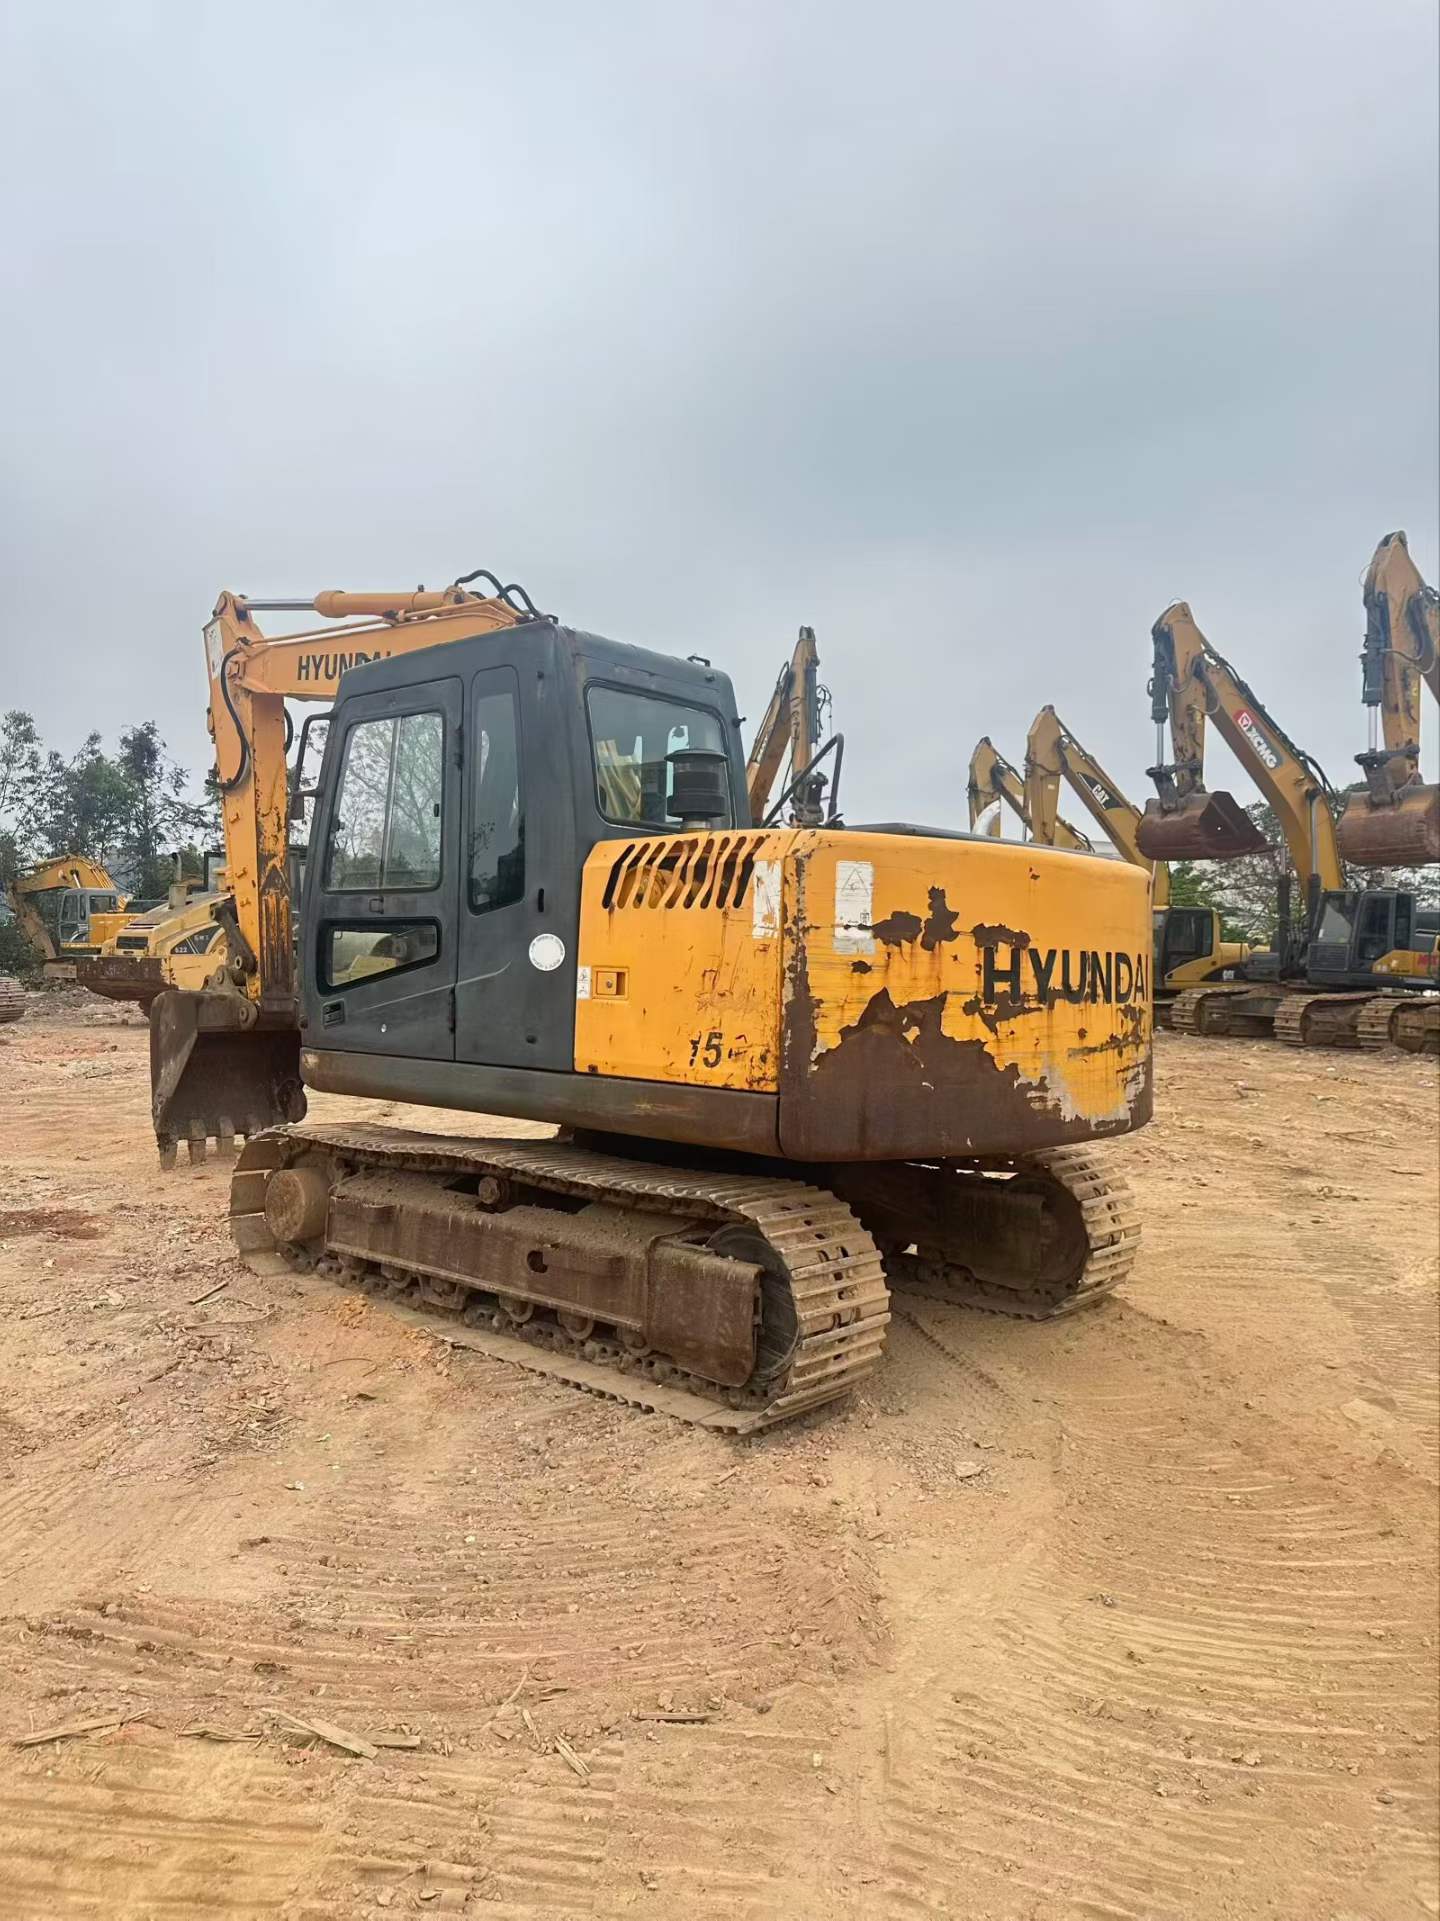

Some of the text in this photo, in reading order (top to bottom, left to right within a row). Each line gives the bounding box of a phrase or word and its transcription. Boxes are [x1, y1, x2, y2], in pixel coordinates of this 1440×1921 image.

[1245, 726, 1277, 769] XCMG
[1092, 784, 1110, 805] CAT
[983, 947, 1149, 1004] HYUNDAI
